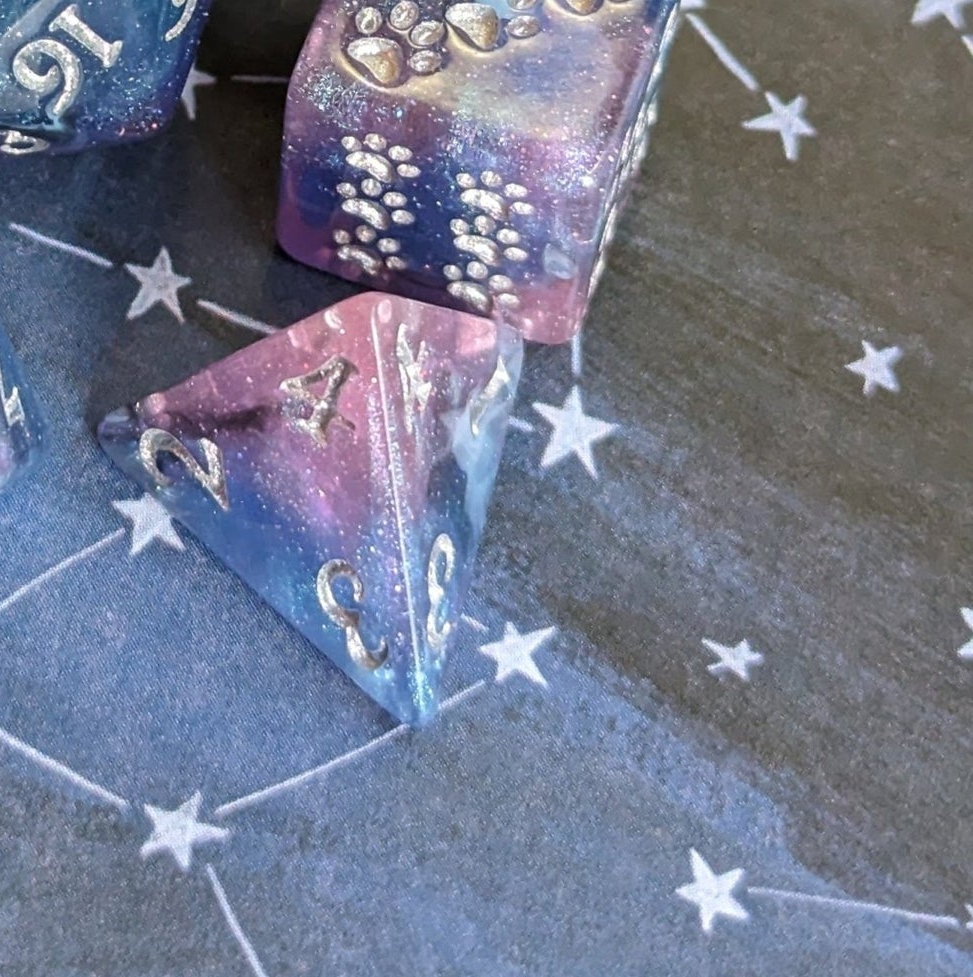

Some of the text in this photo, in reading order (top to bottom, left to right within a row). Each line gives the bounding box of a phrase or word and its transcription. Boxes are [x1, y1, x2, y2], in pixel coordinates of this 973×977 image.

[279, 356, 359, 445] 4
[139, 428, 229, 511] 2
[316, 559, 389, 672] 3
